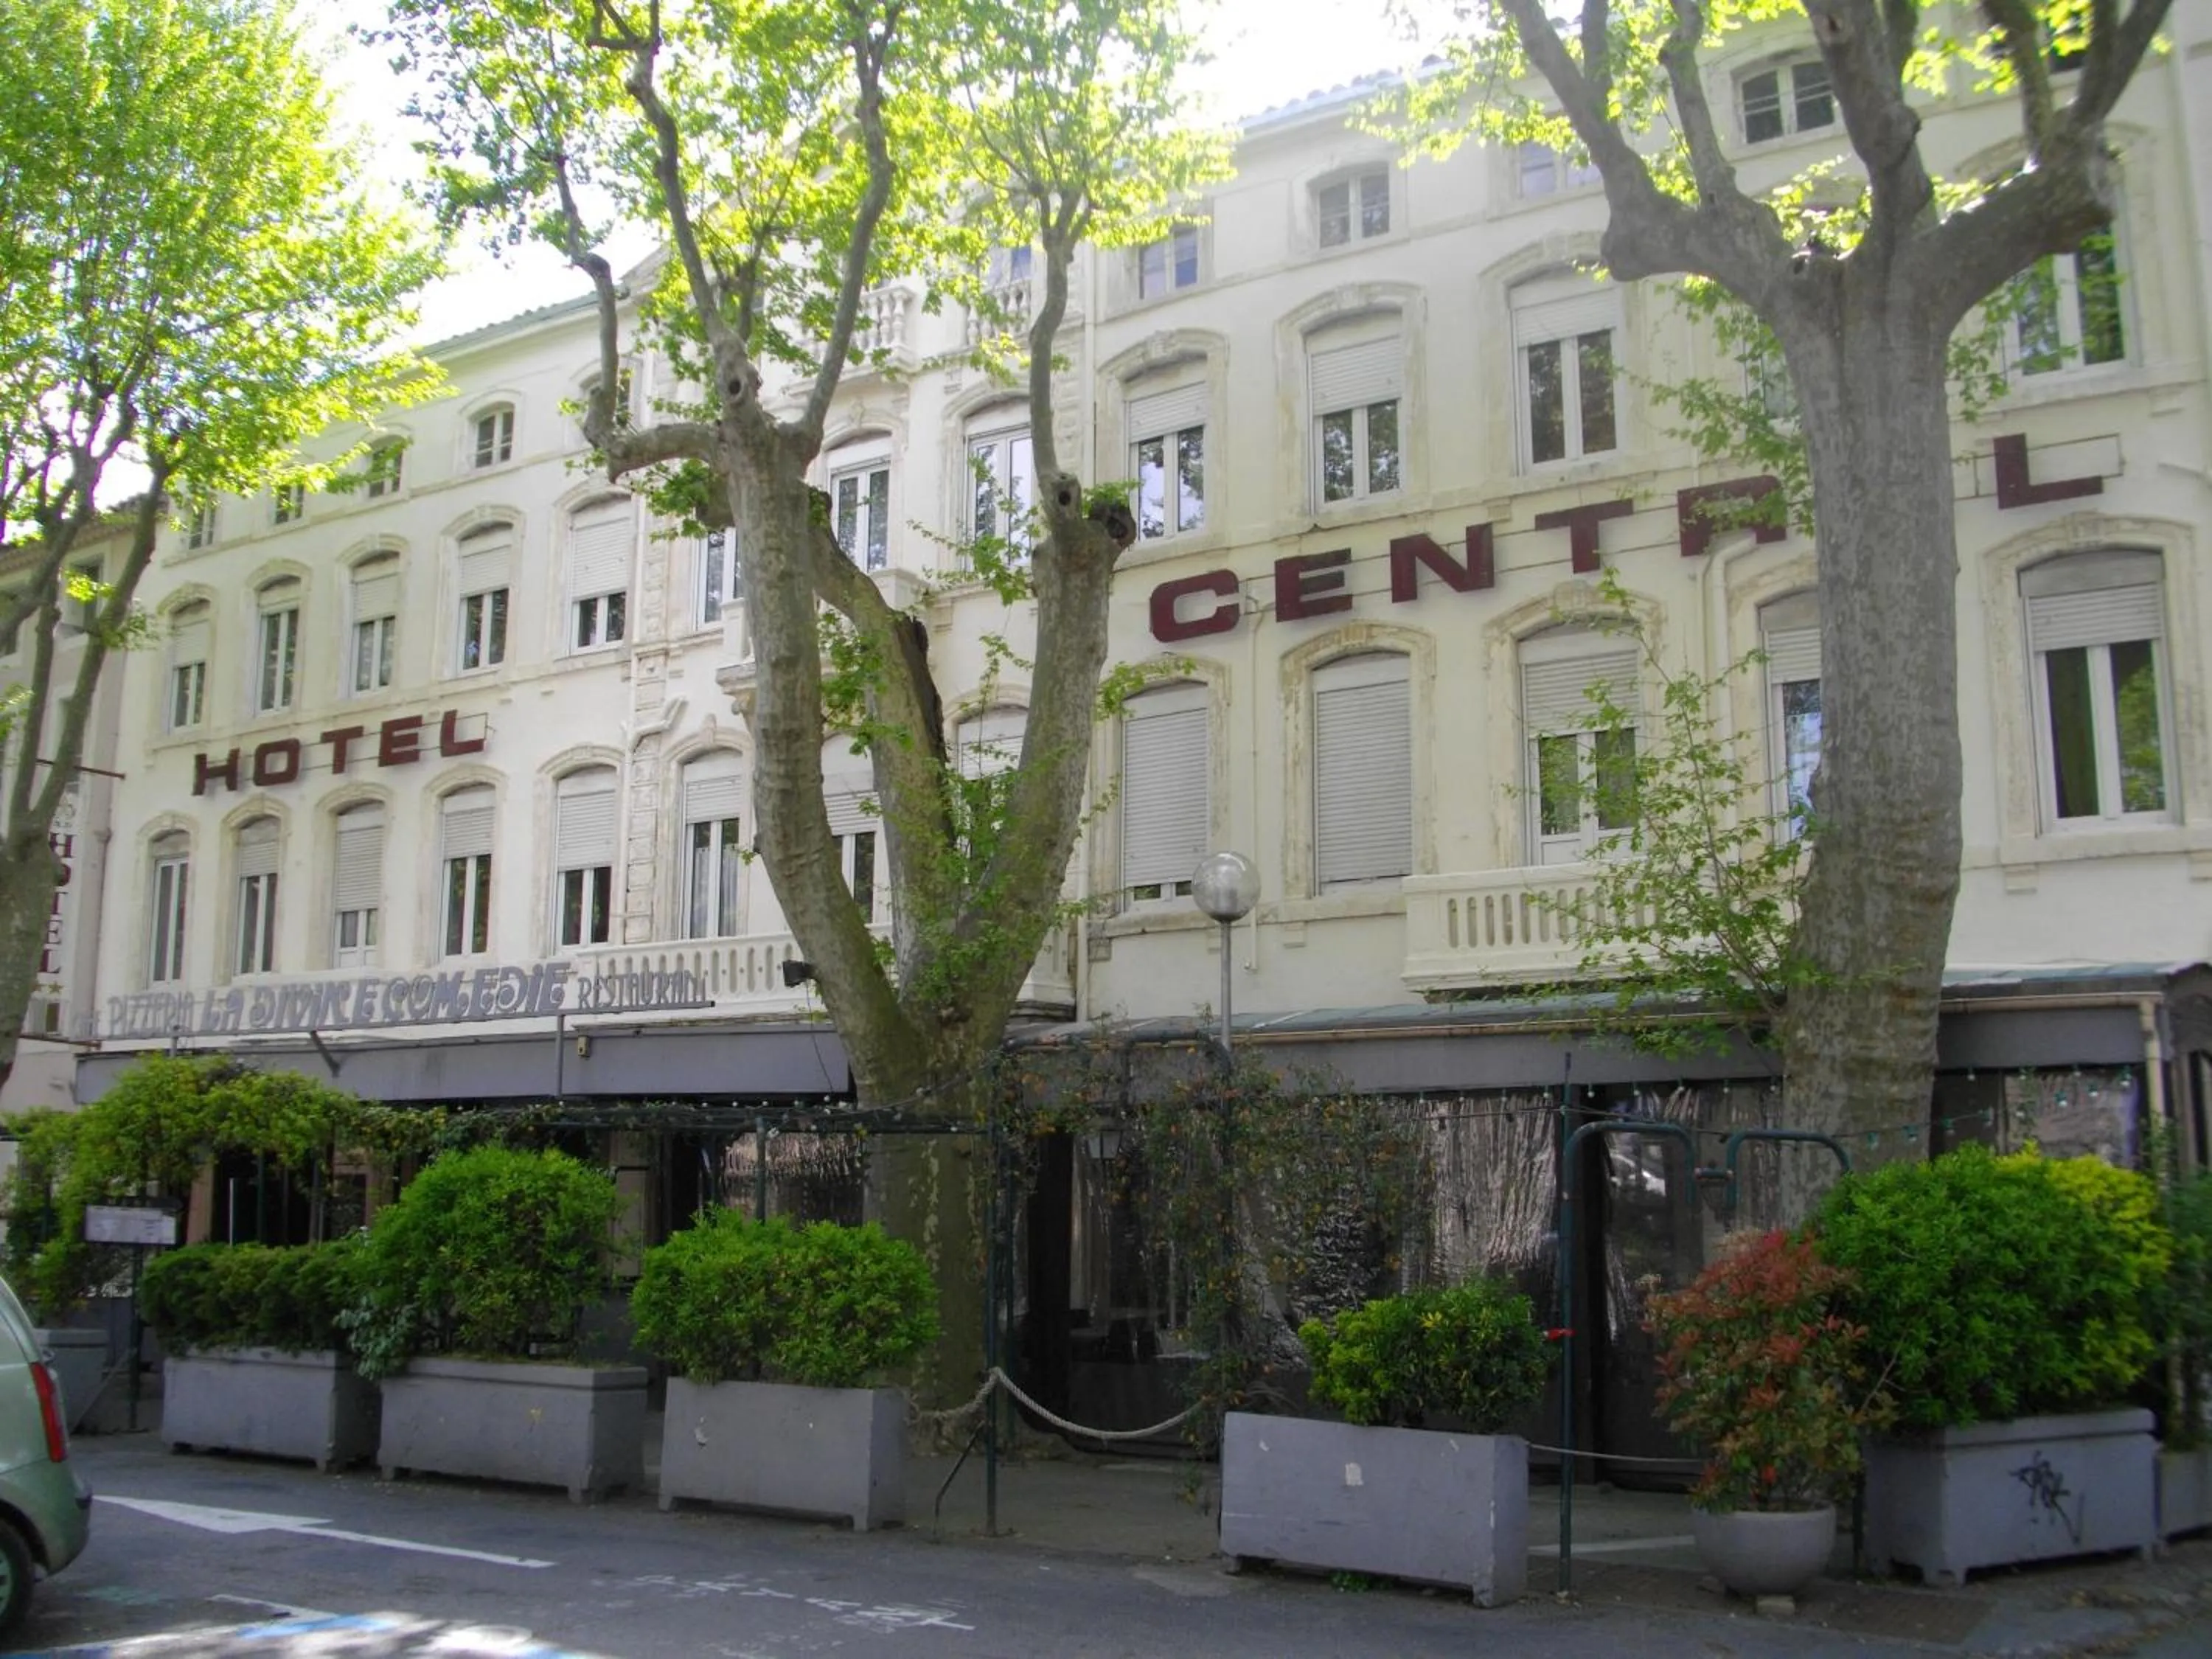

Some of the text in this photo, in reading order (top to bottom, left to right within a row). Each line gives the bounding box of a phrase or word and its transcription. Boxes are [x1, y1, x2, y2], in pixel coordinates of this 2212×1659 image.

[1149, 434, 2104, 642] CENTRL
[192, 709, 487, 796] HOTEL
[201, 989, 244, 1032] LA
[249, 977, 380, 1029] DIVINE
[380, 961, 571, 1023] COMEDIE
